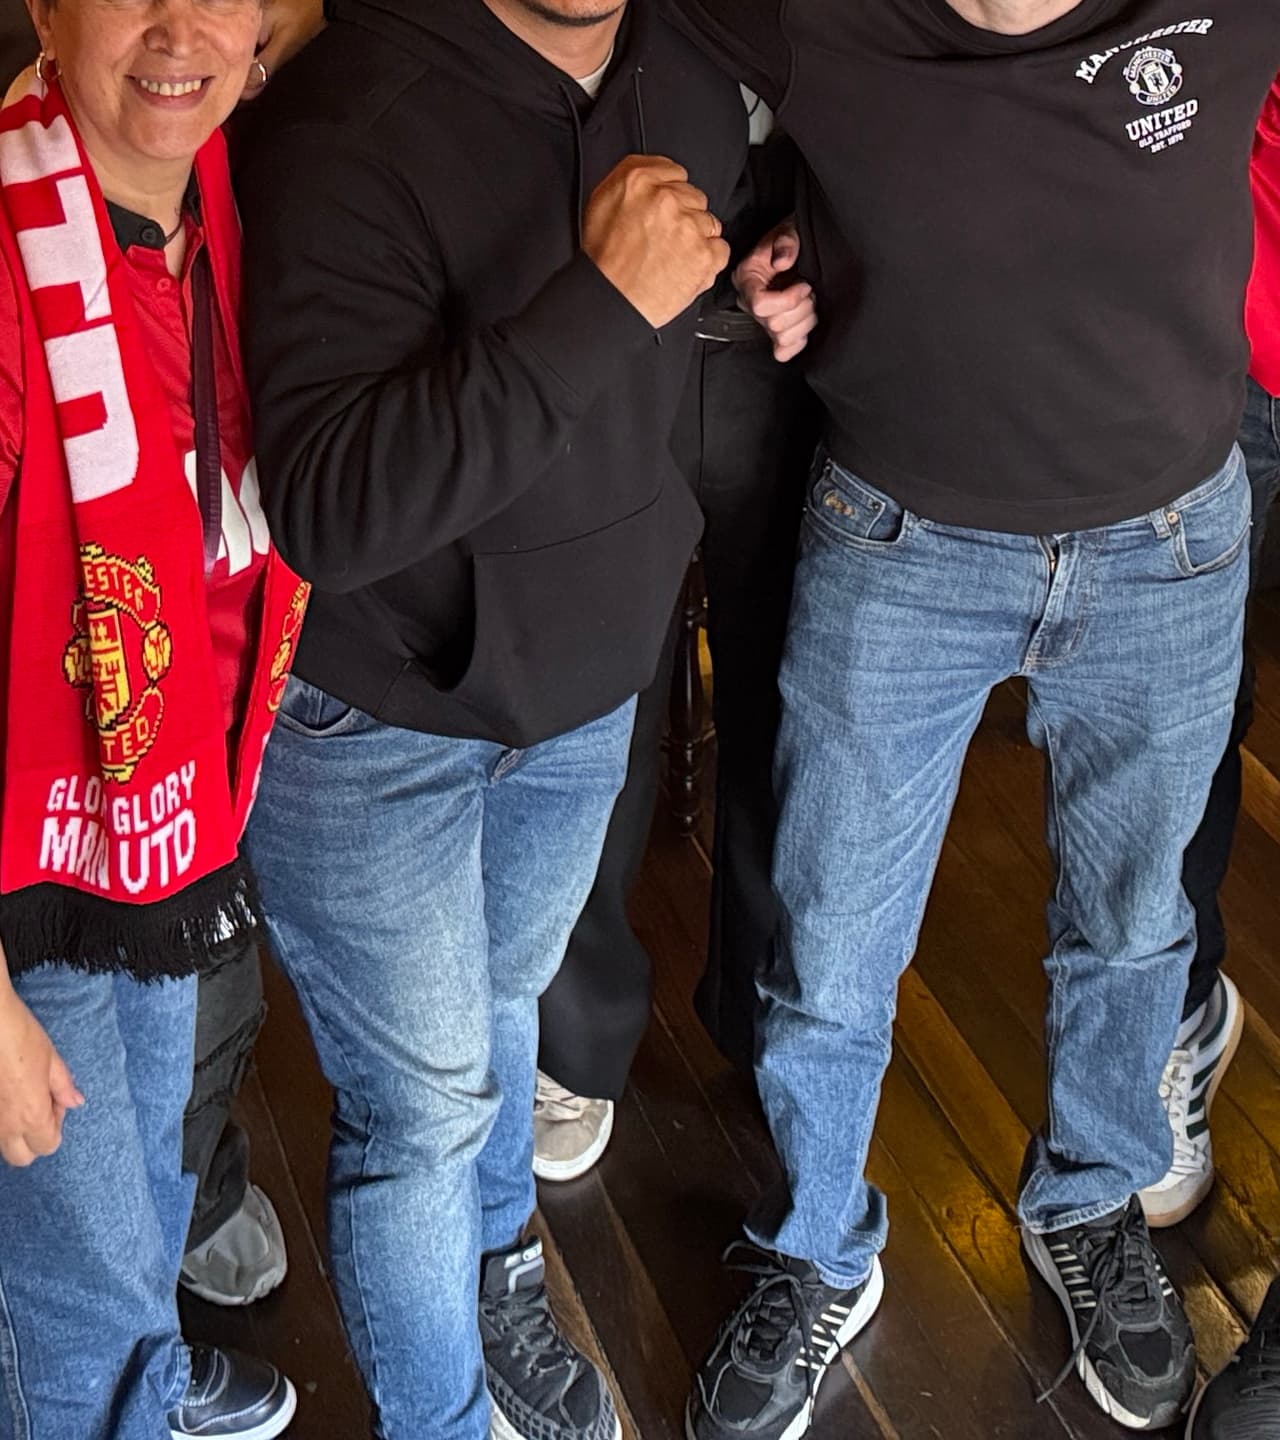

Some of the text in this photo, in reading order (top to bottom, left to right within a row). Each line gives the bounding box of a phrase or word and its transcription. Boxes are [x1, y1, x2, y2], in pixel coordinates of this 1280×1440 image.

[1125, 99, 1198, 141] UNITED
[1138, 136, 1154, 148] OLD
[84, 564, 144, 611] ESTER
[104, 716, 149, 761] TED
[113, 760, 196, 836] GLORY
[39, 808, 196, 894] MAN UTD
